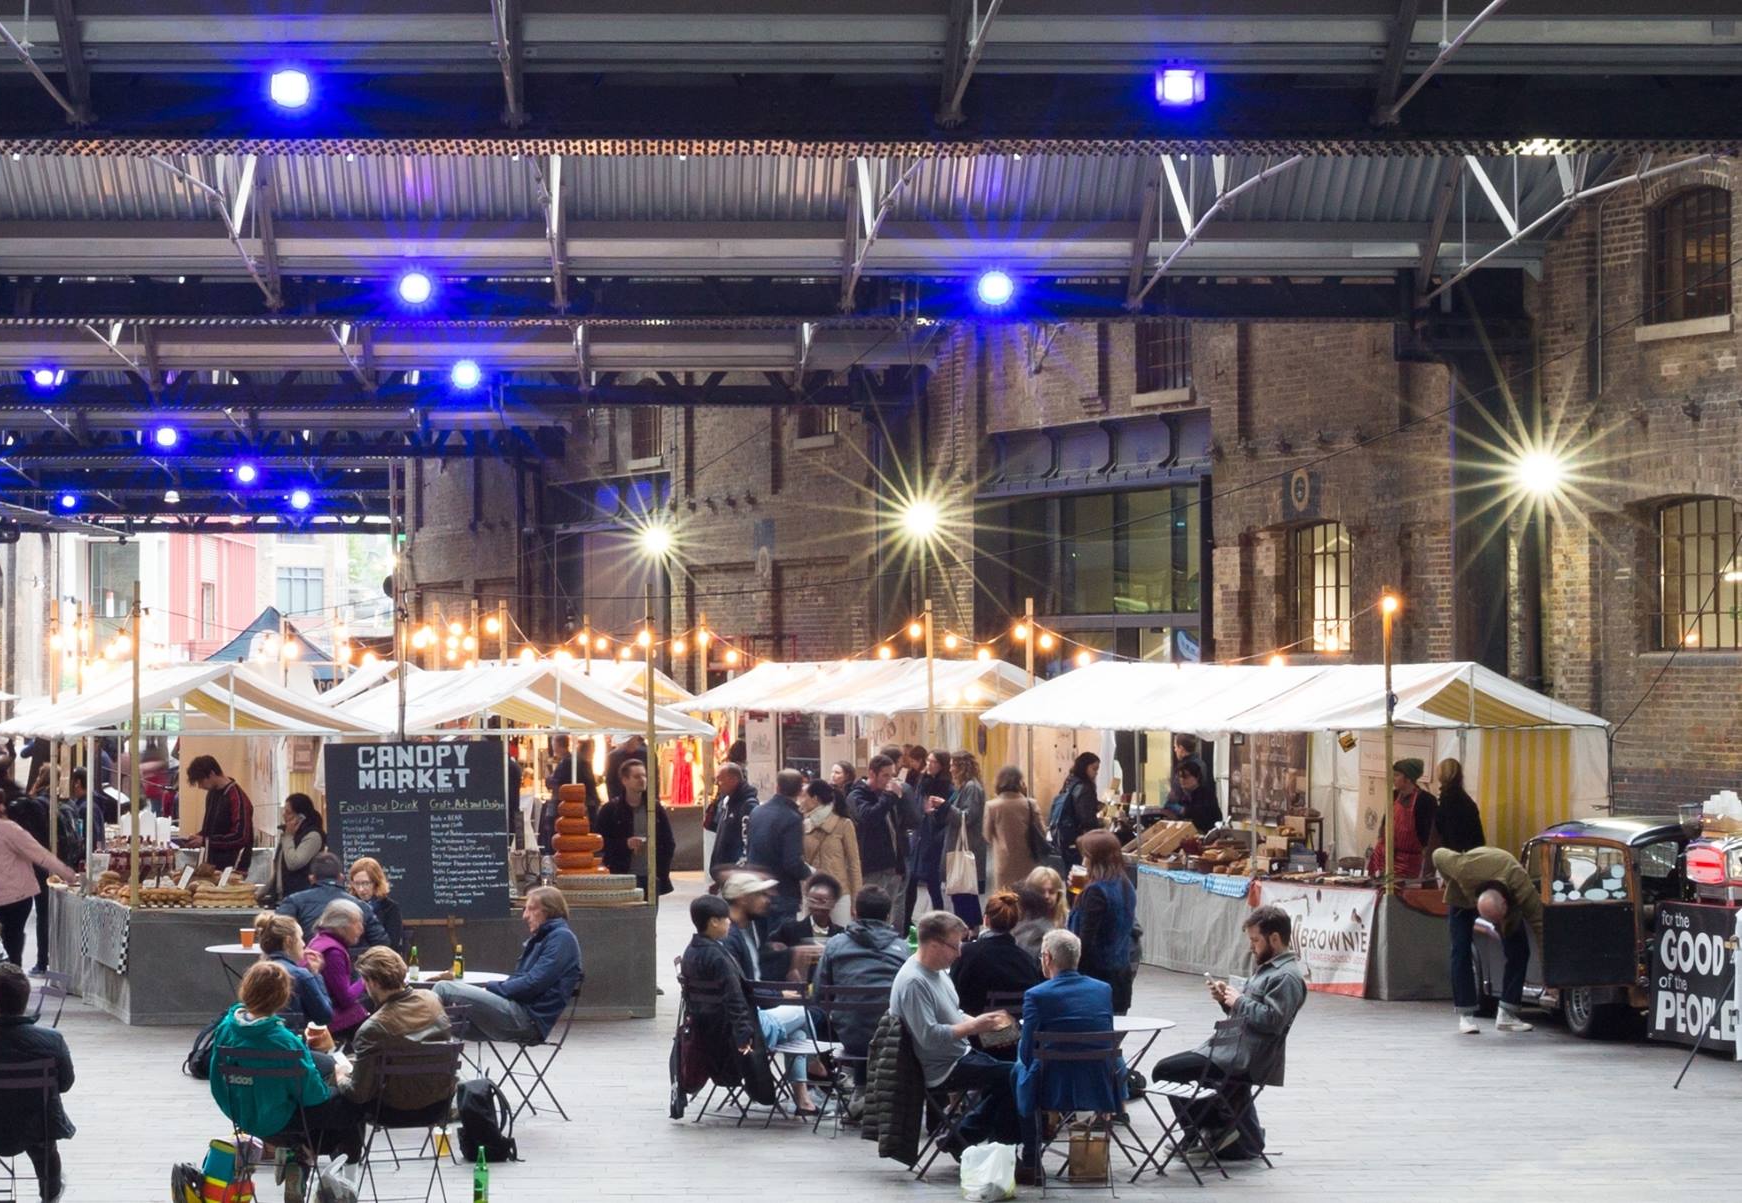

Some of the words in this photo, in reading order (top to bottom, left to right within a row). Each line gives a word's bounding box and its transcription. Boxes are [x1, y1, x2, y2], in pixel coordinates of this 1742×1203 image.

[358, 744, 469, 768] CANOPY
[359, 768, 470, 790] MARKET
[339, 801, 369, 812] Food
[372, 802, 388, 810] and
[391, 800, 419, 810] Drink
[455, 798, 468, 809] Art
[470, 799, 481, 808] and
[1662, 910, 1673, 926] for
[1674, 913, 1690, 928] the
[1301, 928, 1367, 953] BROWNIE
[1660, 929, 1725, 976] GOOD
[1659, 973, 1673, 988] of
[1674, 975, 1688, 991] the
[1655, 990, 1736, 1041] PEOPLE
